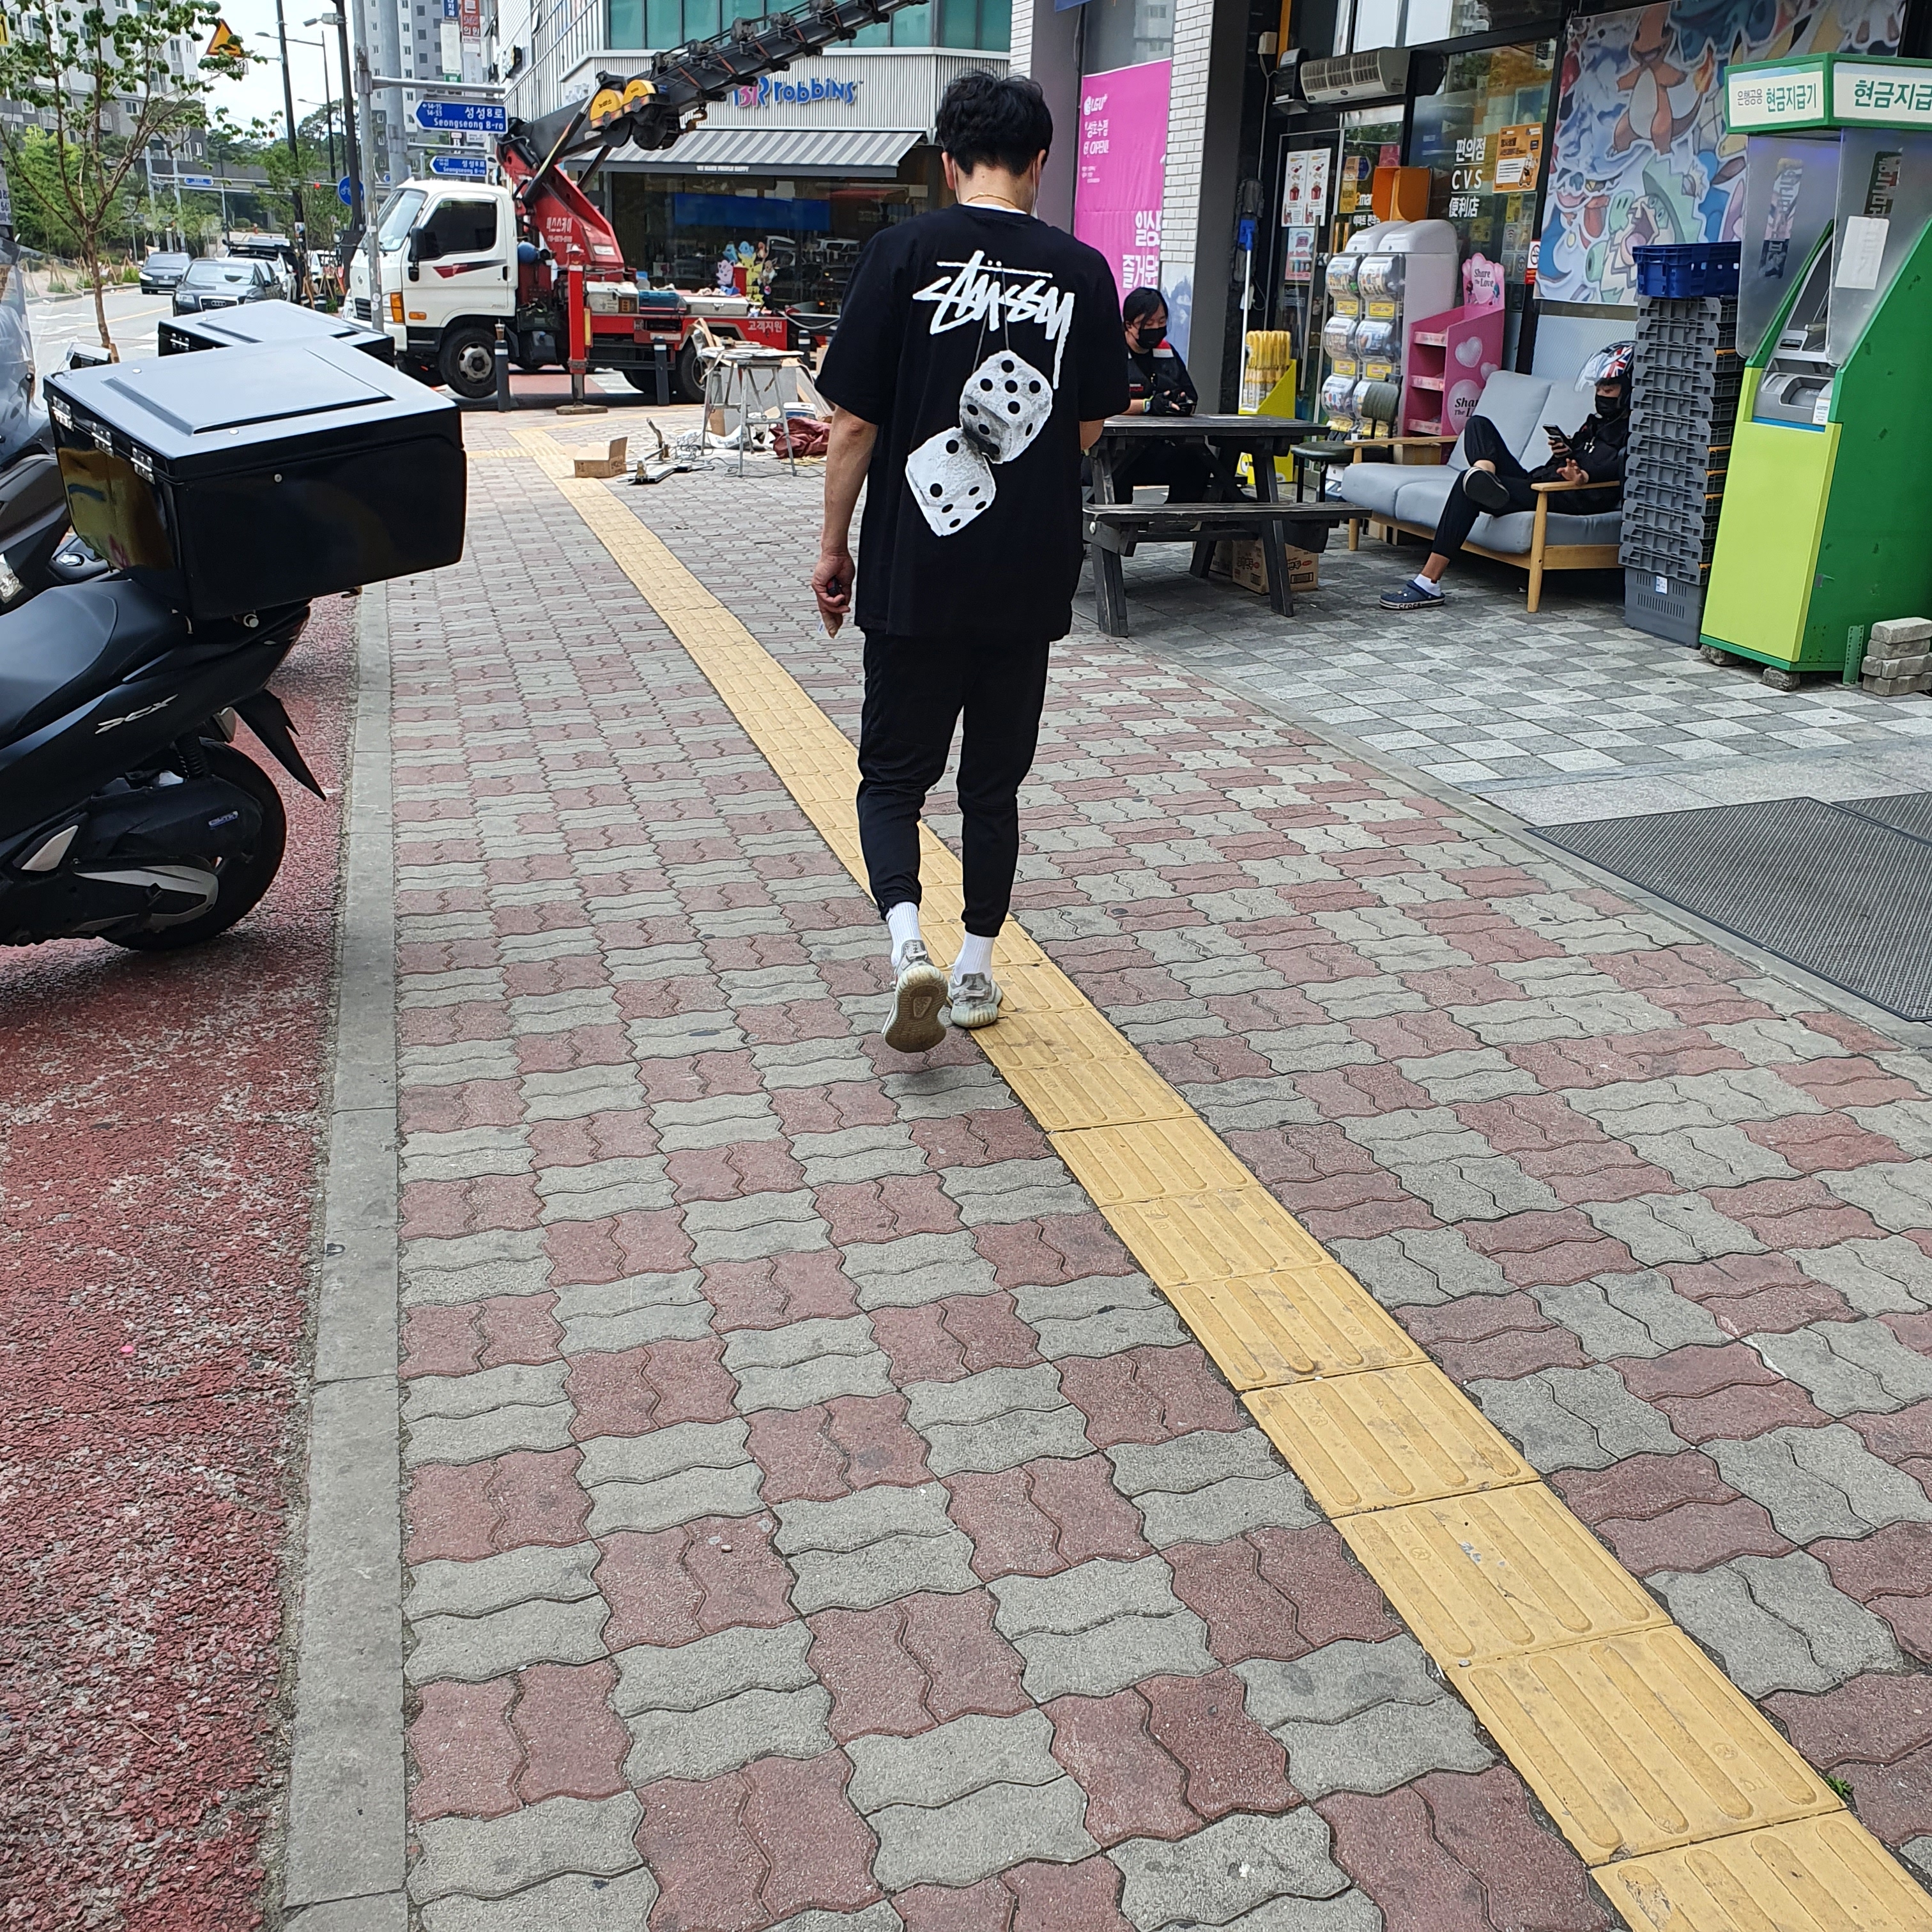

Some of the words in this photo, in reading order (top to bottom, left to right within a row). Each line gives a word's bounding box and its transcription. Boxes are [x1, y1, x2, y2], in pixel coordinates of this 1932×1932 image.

[1766, 82, 1816, 112] 현금지급기
[464, 106, 504, 120] 성성8로
[433, 118, 483, 130] Seongseong
[486, 121, 503, 130] 8-ro
[1455, 135, 1487, 162] 편의점
[1451, 169, 1483, 190] CVS
[1448, 195, 1480, 218] 便利店
[1474, 268, 1491, 279] Share
[1480, 277, 1494, 288] Love
[747, 321, 783, 334] 고객지원
[95, 693, 179, 735] PCX
